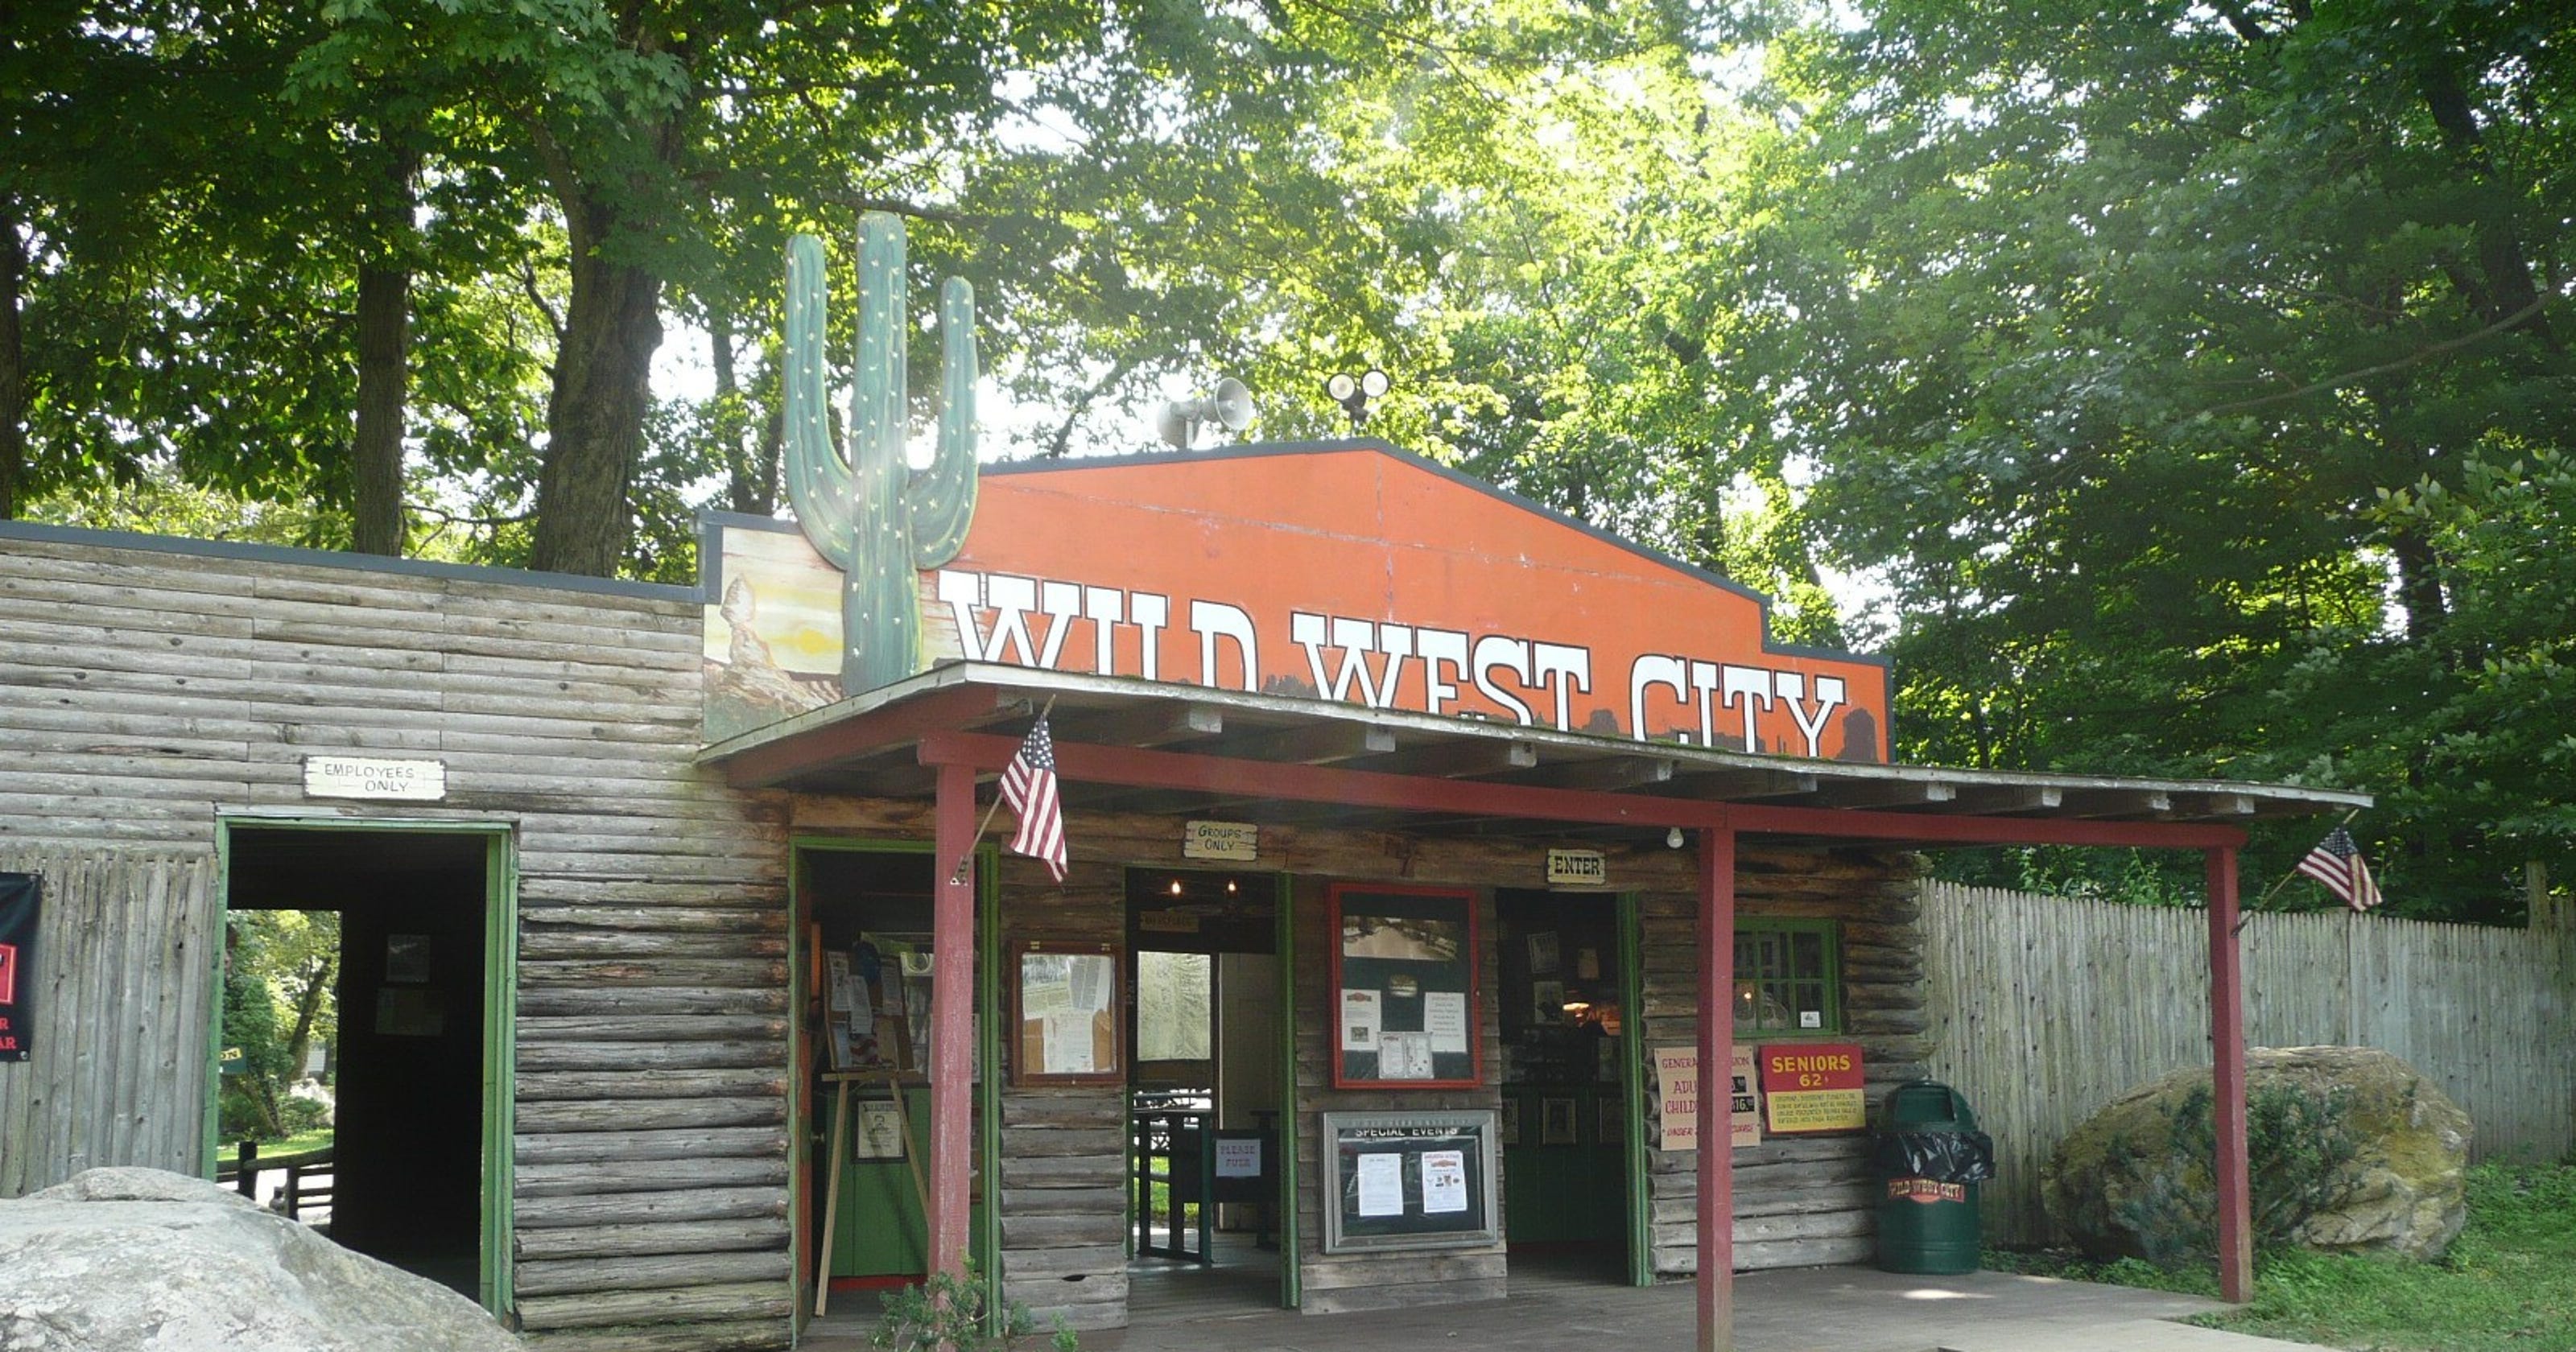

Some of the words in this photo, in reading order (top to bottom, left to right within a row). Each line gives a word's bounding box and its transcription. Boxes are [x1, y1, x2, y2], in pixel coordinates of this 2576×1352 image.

[938, 569, 1260, 693] WILD
[1290, 611, 1591, 732] WEST
[1630, 653, 1846, 757] CITY
[324, 764, 414, 779] EMPLOYEES
[365, 781, 409, 792] ONLY
[1198, 825, 1241, 839] GROUPS
[1204, 838, 1235, 851] ONLY
[1554, 855, 1600, 876] ENTER
[1662, 1057, 1698, 1070] GENERA
[1771, 1054, 1852, 1074] SENIORS
[1673, 1080, 1698, 1095] ADU
[1665, 1099, 1698, 1115] CHILD
